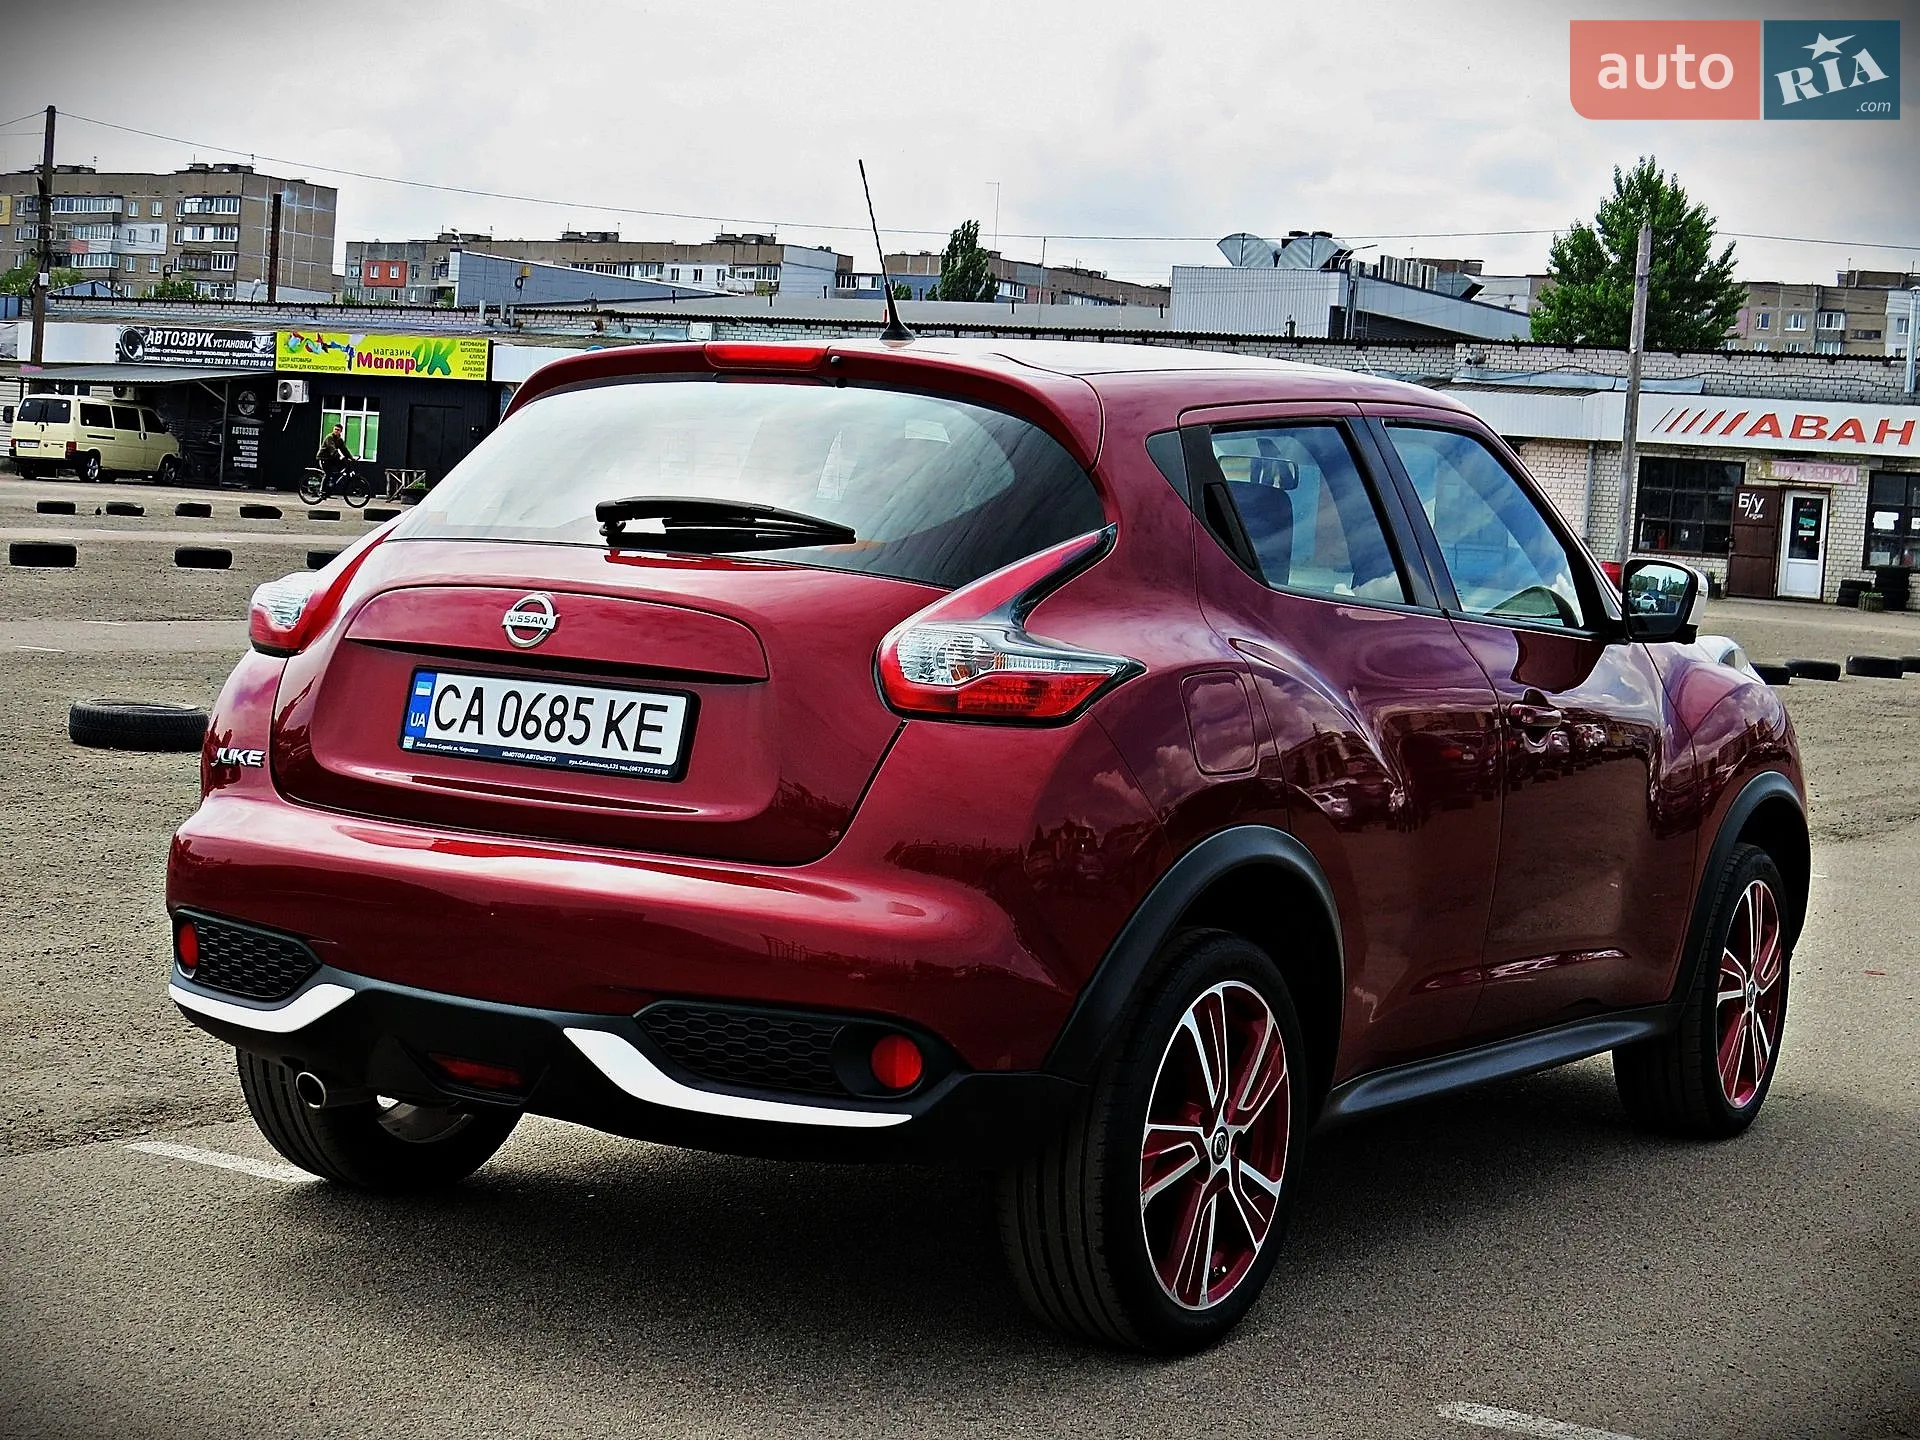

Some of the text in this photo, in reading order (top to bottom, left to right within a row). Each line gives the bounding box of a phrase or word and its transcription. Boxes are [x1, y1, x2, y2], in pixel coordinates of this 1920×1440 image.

[146, 330, 253, 350] АВТОЗВУК УСТАНОВКА
[373, 348, 411, 356] магазин
[1744, 412, 1916, 446] АВАН
[507, 615, 548, 626] NISSAN
[410, 712, 426, 728] UA
[434, 684, 669, 755] CA 0685 KE
[210, 747, 266, 767] JUKE
